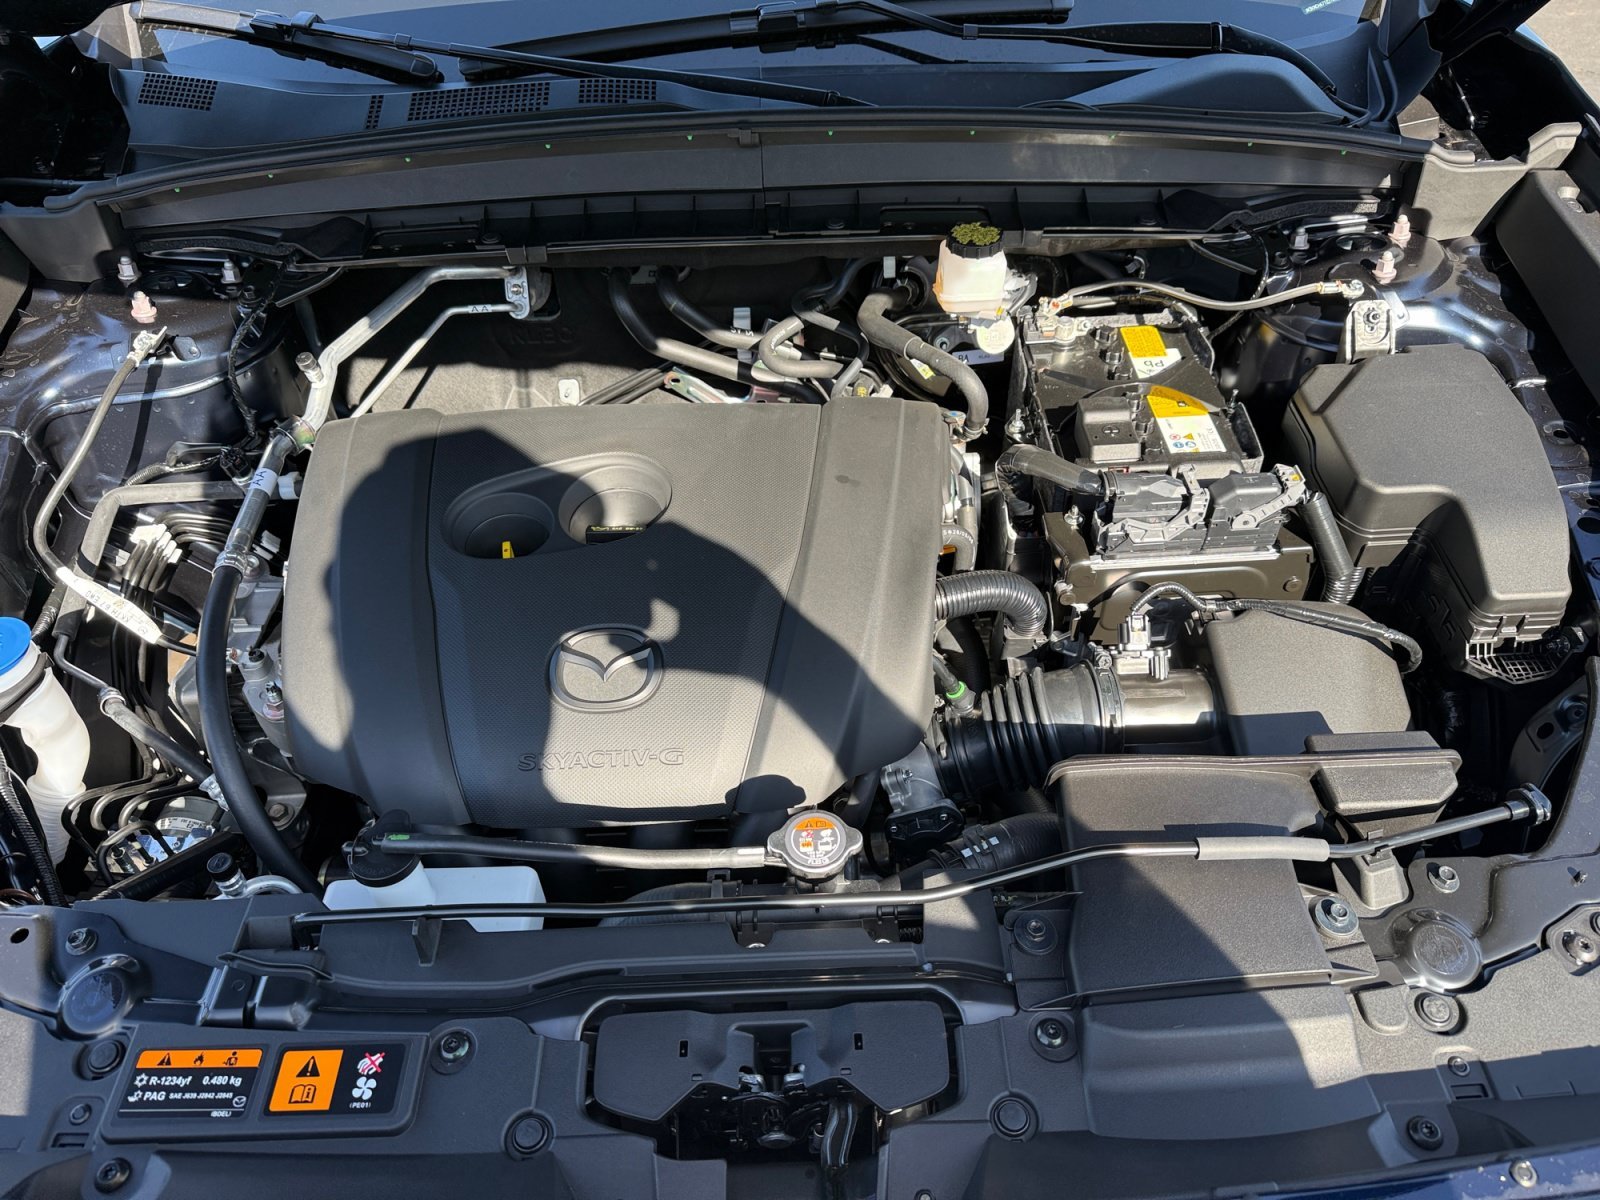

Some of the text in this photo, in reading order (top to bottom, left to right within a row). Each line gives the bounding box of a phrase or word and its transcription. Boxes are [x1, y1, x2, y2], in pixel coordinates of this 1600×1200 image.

[1144, 359, 1165, 369] Pb
[518, 747, 685, 772] SKYACTIV-G
[149, 1075, 242, 1087] R-1234yf 0.480 kg
[143, 1091, 166, 1101] PAG
[168, 1092, 182, 1100] SAE
